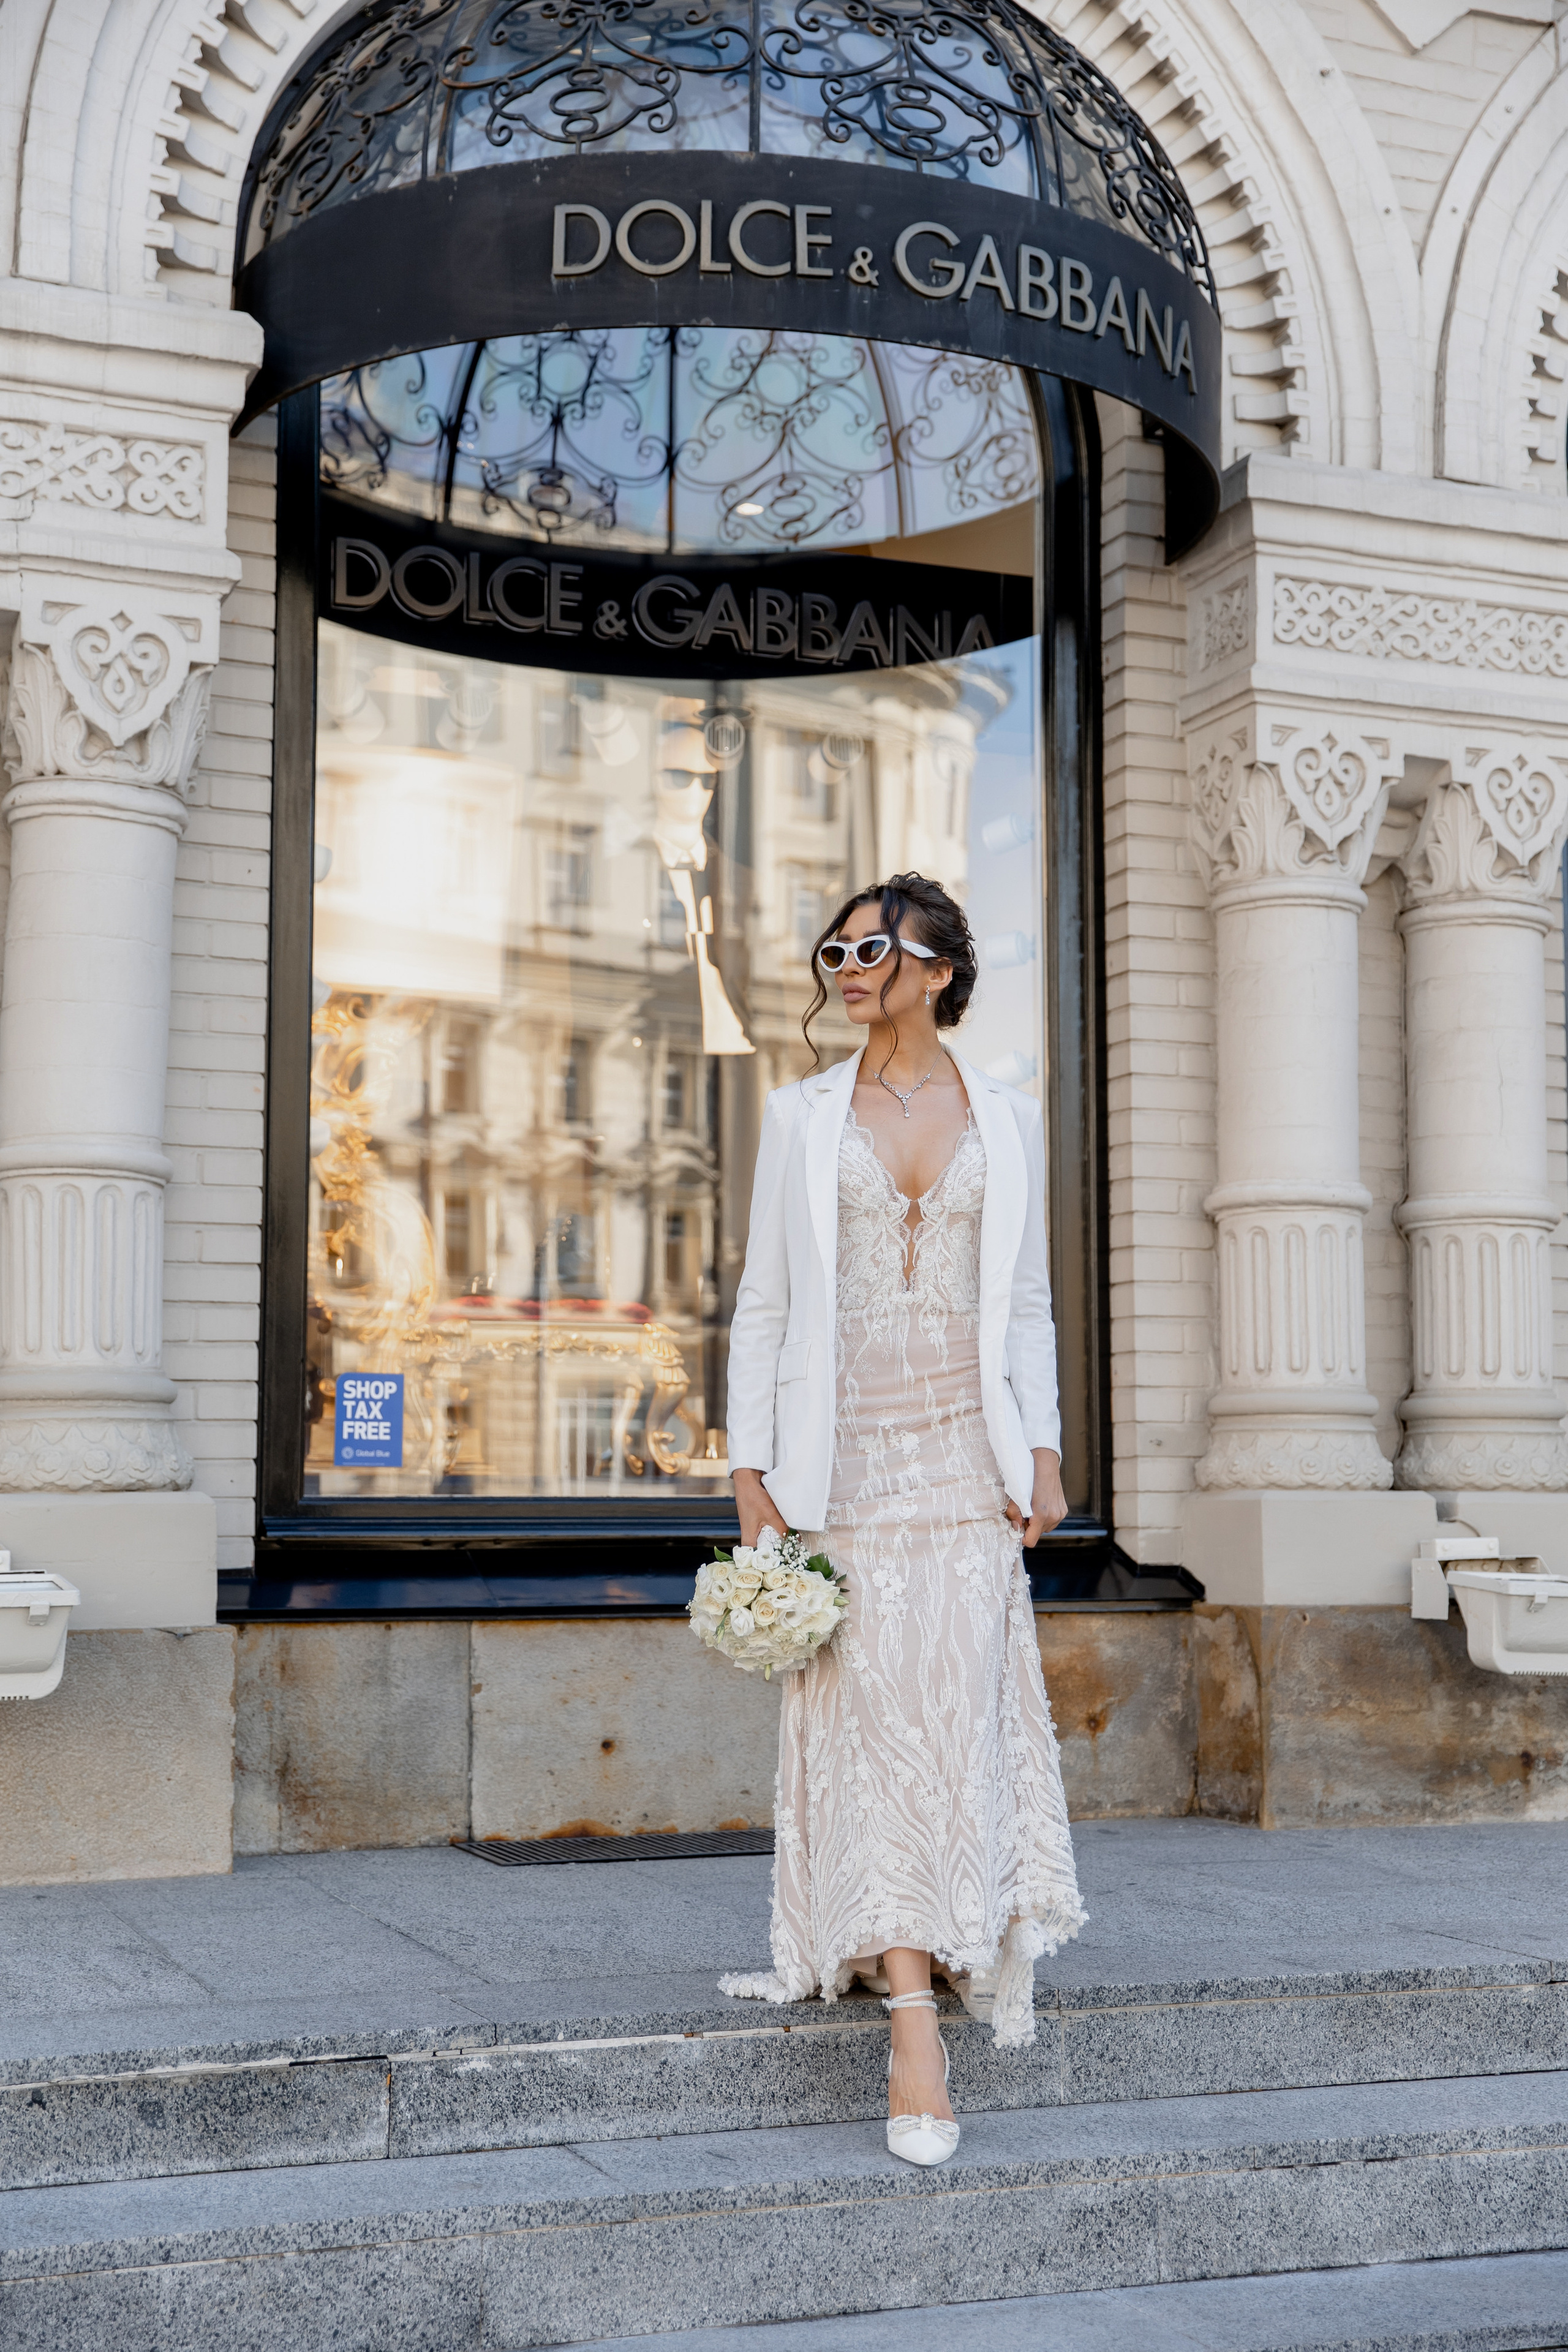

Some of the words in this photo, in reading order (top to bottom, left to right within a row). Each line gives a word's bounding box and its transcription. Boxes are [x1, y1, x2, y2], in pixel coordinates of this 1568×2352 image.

[552, 199, 834, 277] DOLCE
[848, 246, 879, 286] &
[893, 221, 1198, 395] GABBANA
[331, 536, 584, 636] DOLCE
[594, 600, 635, 641] &
[343, 1379, 398, 1400] SHOP
[342, 1400, 383, 1420] TAX
[342, 1421, 391, 1440] FREE
